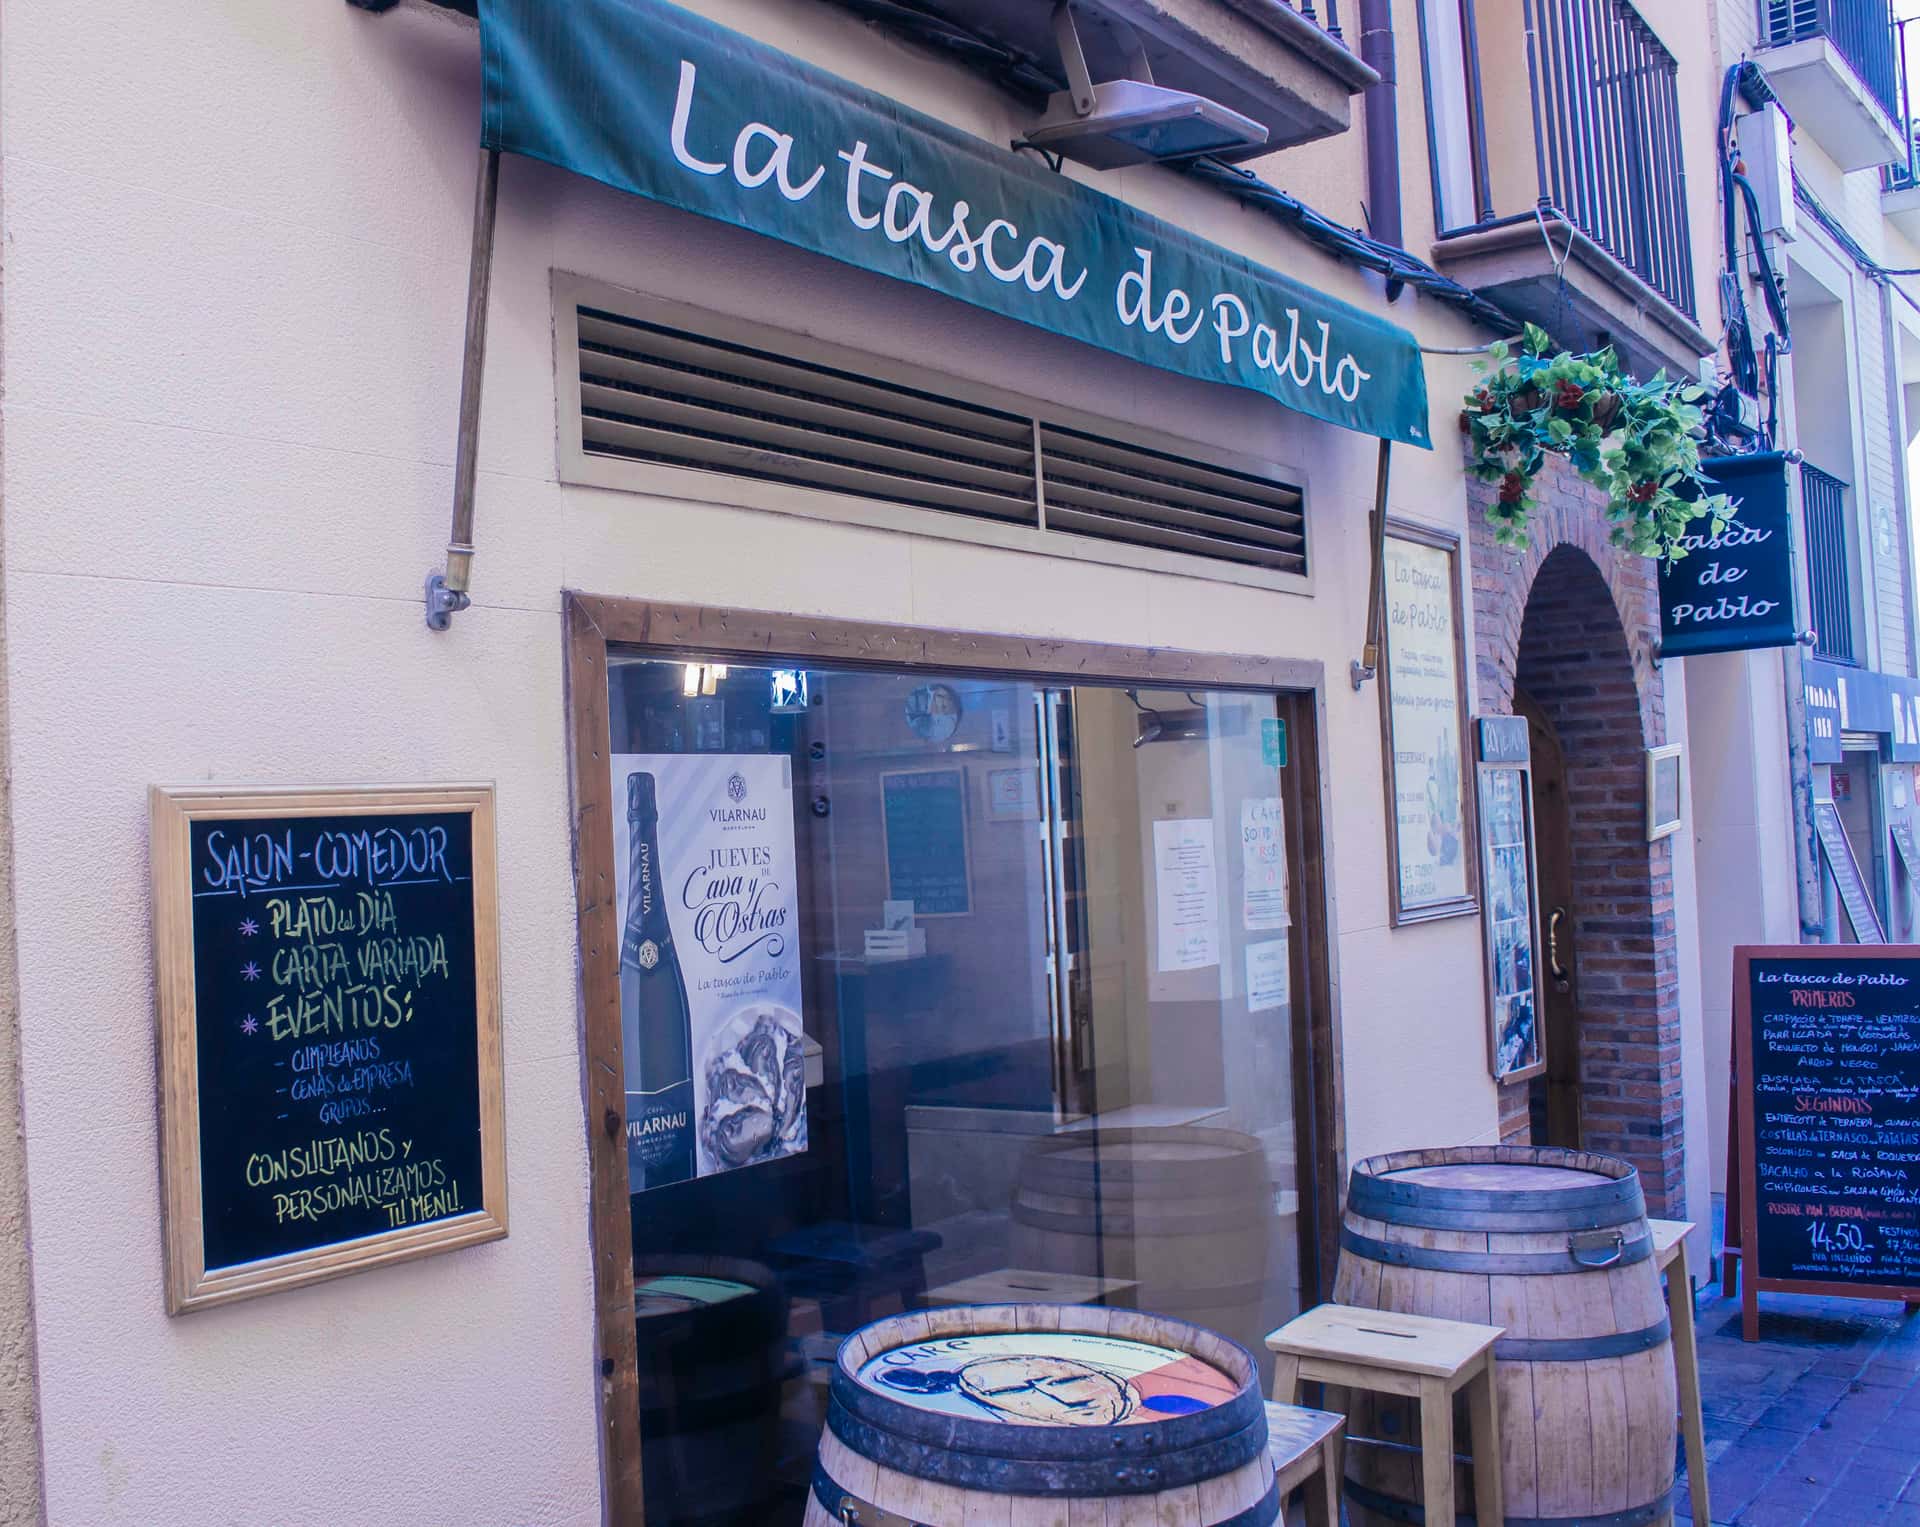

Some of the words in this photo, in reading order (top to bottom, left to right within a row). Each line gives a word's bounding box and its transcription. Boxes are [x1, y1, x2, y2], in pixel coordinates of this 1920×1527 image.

[671, 60, 823, 201] La
[838, 140, 1087, 301] tasca
[1116, 247, 1202, 344] de
[1210, 293, 1371, 402] Pablo
[1698, 562, 1748, 585] de
[1409, 603, 1448, 633] Pablo
[1672, 595, 1780, 626] Pablo
[709, 807, 766, 823] VILARNAU
[708, 846, 771, 871] JUEVES
[641, 842, 651, 916] VILARNAU
[683, 866, 743, 909] Cava
[266, 896, 336, 945] PLATO
[695, 883, 787, 955] Ostras
[272, 943, 353, 993] CARTA
[698, 976, 712, 990] La
[713, 977, 741, 989] tasca
[743, 971, 755, 984] de
[759, 967, 790, 982] Pablo
[1758, 971, 1783, 983] La
[1783, 972, 1831, 984] tasca
[1832, 972, 1857, 984] de
[1857, 974, 1909, 986] Pablo
[1823, 1041, 1836, 1053] de
[291, 1074, 335, 1100] CENAS
[1761, 1074, 1822, 1085] ENSALADA
[1794, 1095, 1872, 1114] SEGUNDOS
[625, 1111, 686, 1138] VILARNAU
[1831, 1150, 1857, 1160] SALSA
